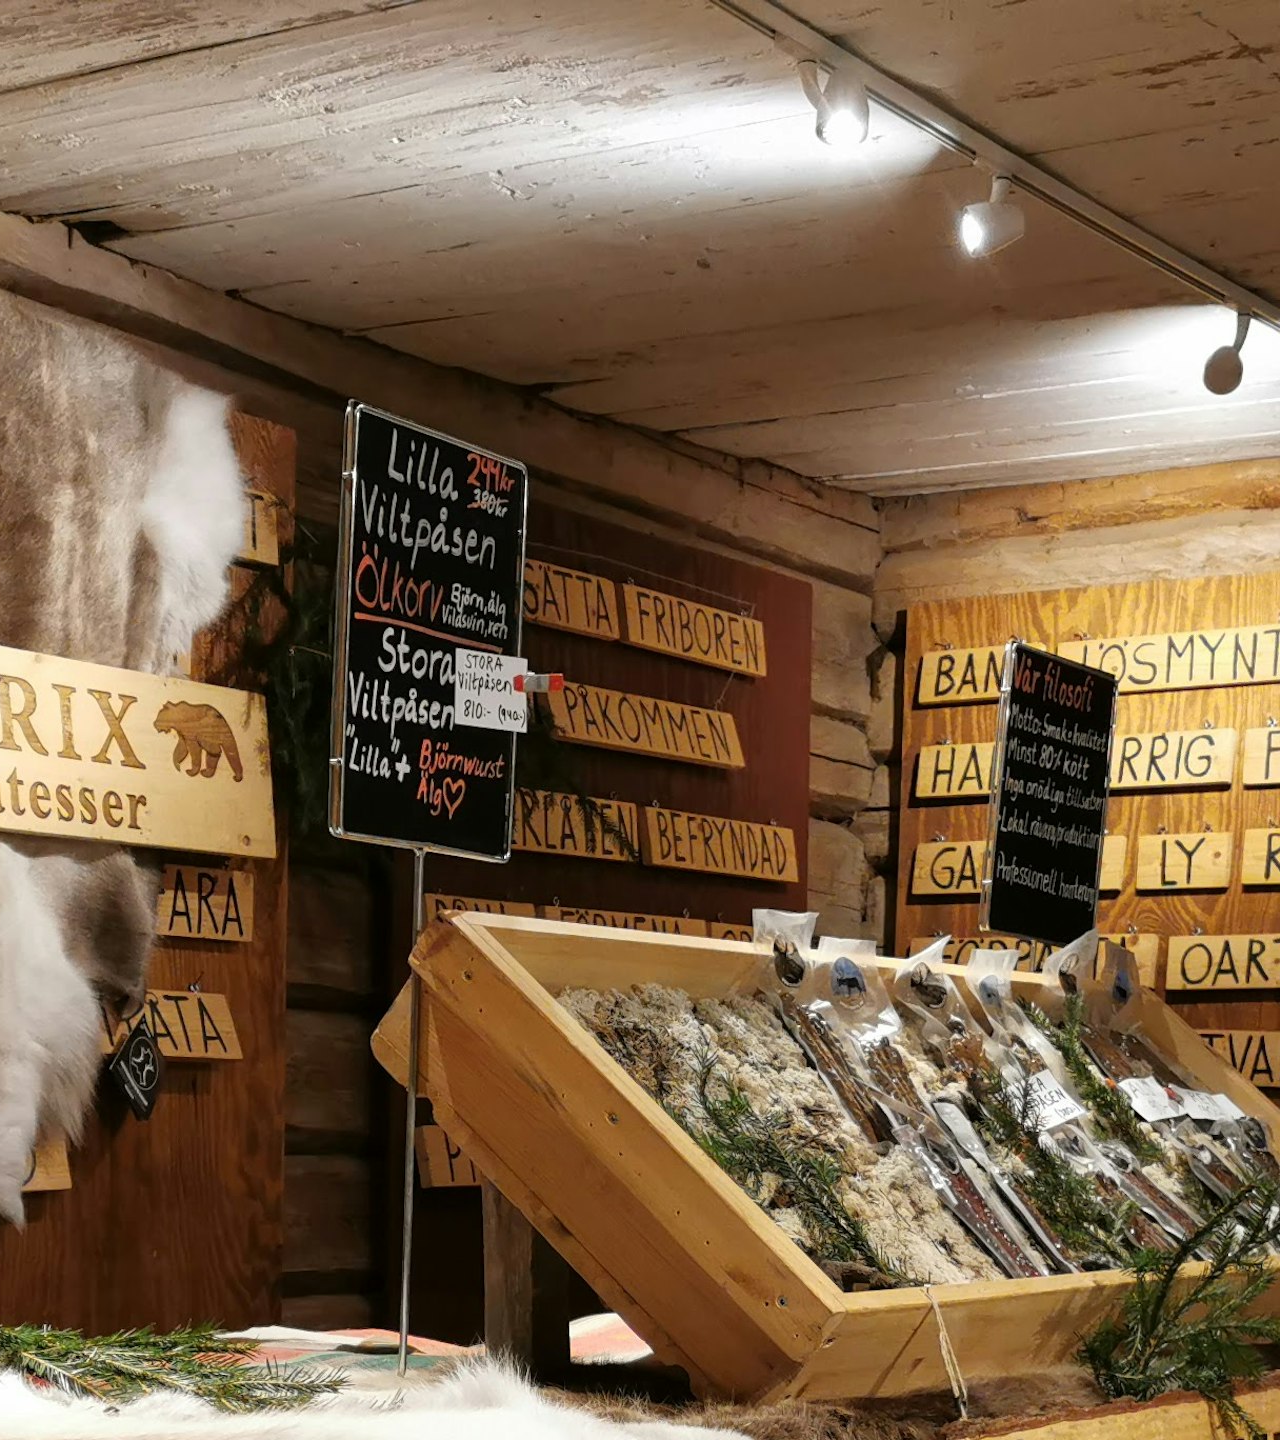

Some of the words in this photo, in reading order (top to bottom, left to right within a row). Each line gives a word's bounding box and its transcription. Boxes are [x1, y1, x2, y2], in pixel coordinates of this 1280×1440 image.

[387, 428, 459, 501] Lilla
[361, 478, 496, 571] Viltpåsen
[355, 541, 444, 622] Ölkorv
[377, 627, 456, 687] Stora
[636, 590, 760, 672] FRIBOREN
[458, 671, 512, 696] Viltpåsen
[464, 653, 504, 672] STORA
[1013, 653, 1041, 694] Vår
[1042, 661, 1095, 713] filosofi
[348, 671, 455, 740] Viltpåsen
[562, 684, 733, 761] PÅKOMMEN
[419, 738, 506, 779] Björnwurst
[1062, 751, 1091, 781] kött
[416, 770, 443, 817] Älg
[656, 810, 787, 876] BEFRYNDAD
[1160, 837, 1207, 886] LY
[160, 868, 244, 937] ARA
[996, 851, 1057, 896] Professionell
